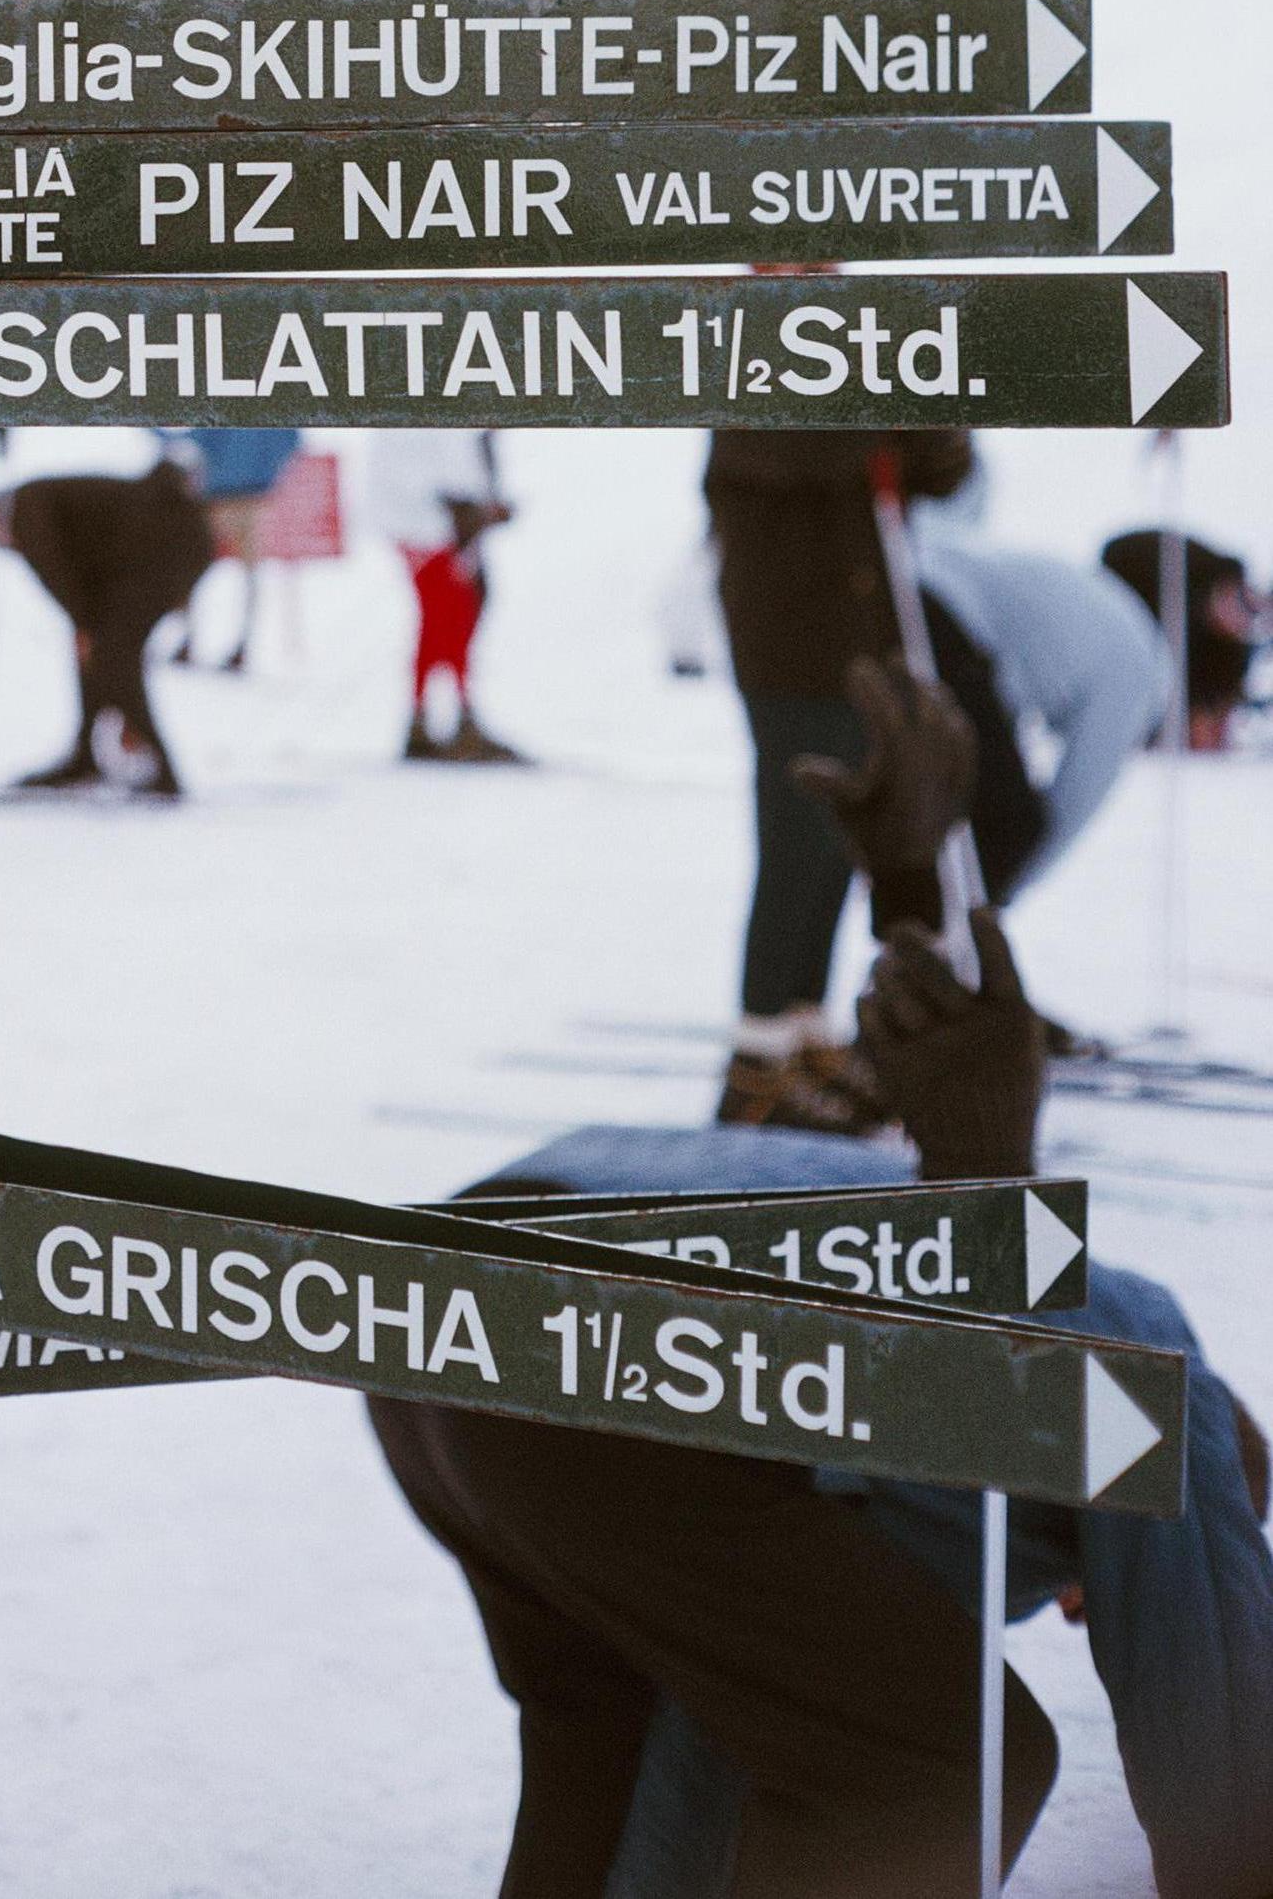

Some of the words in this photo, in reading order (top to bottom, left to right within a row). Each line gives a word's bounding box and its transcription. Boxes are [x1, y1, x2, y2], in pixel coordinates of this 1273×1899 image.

[822, 13, 988, 93] Nair
[138, 161, 295, 246] PIZ
[342, 158, 574, 241] NAIR
[615, 171, 731, 226] VAL
[748, 164, 1070, 225] SUVRETTA
[35, 1224, 501, 1384] GRISCHA
